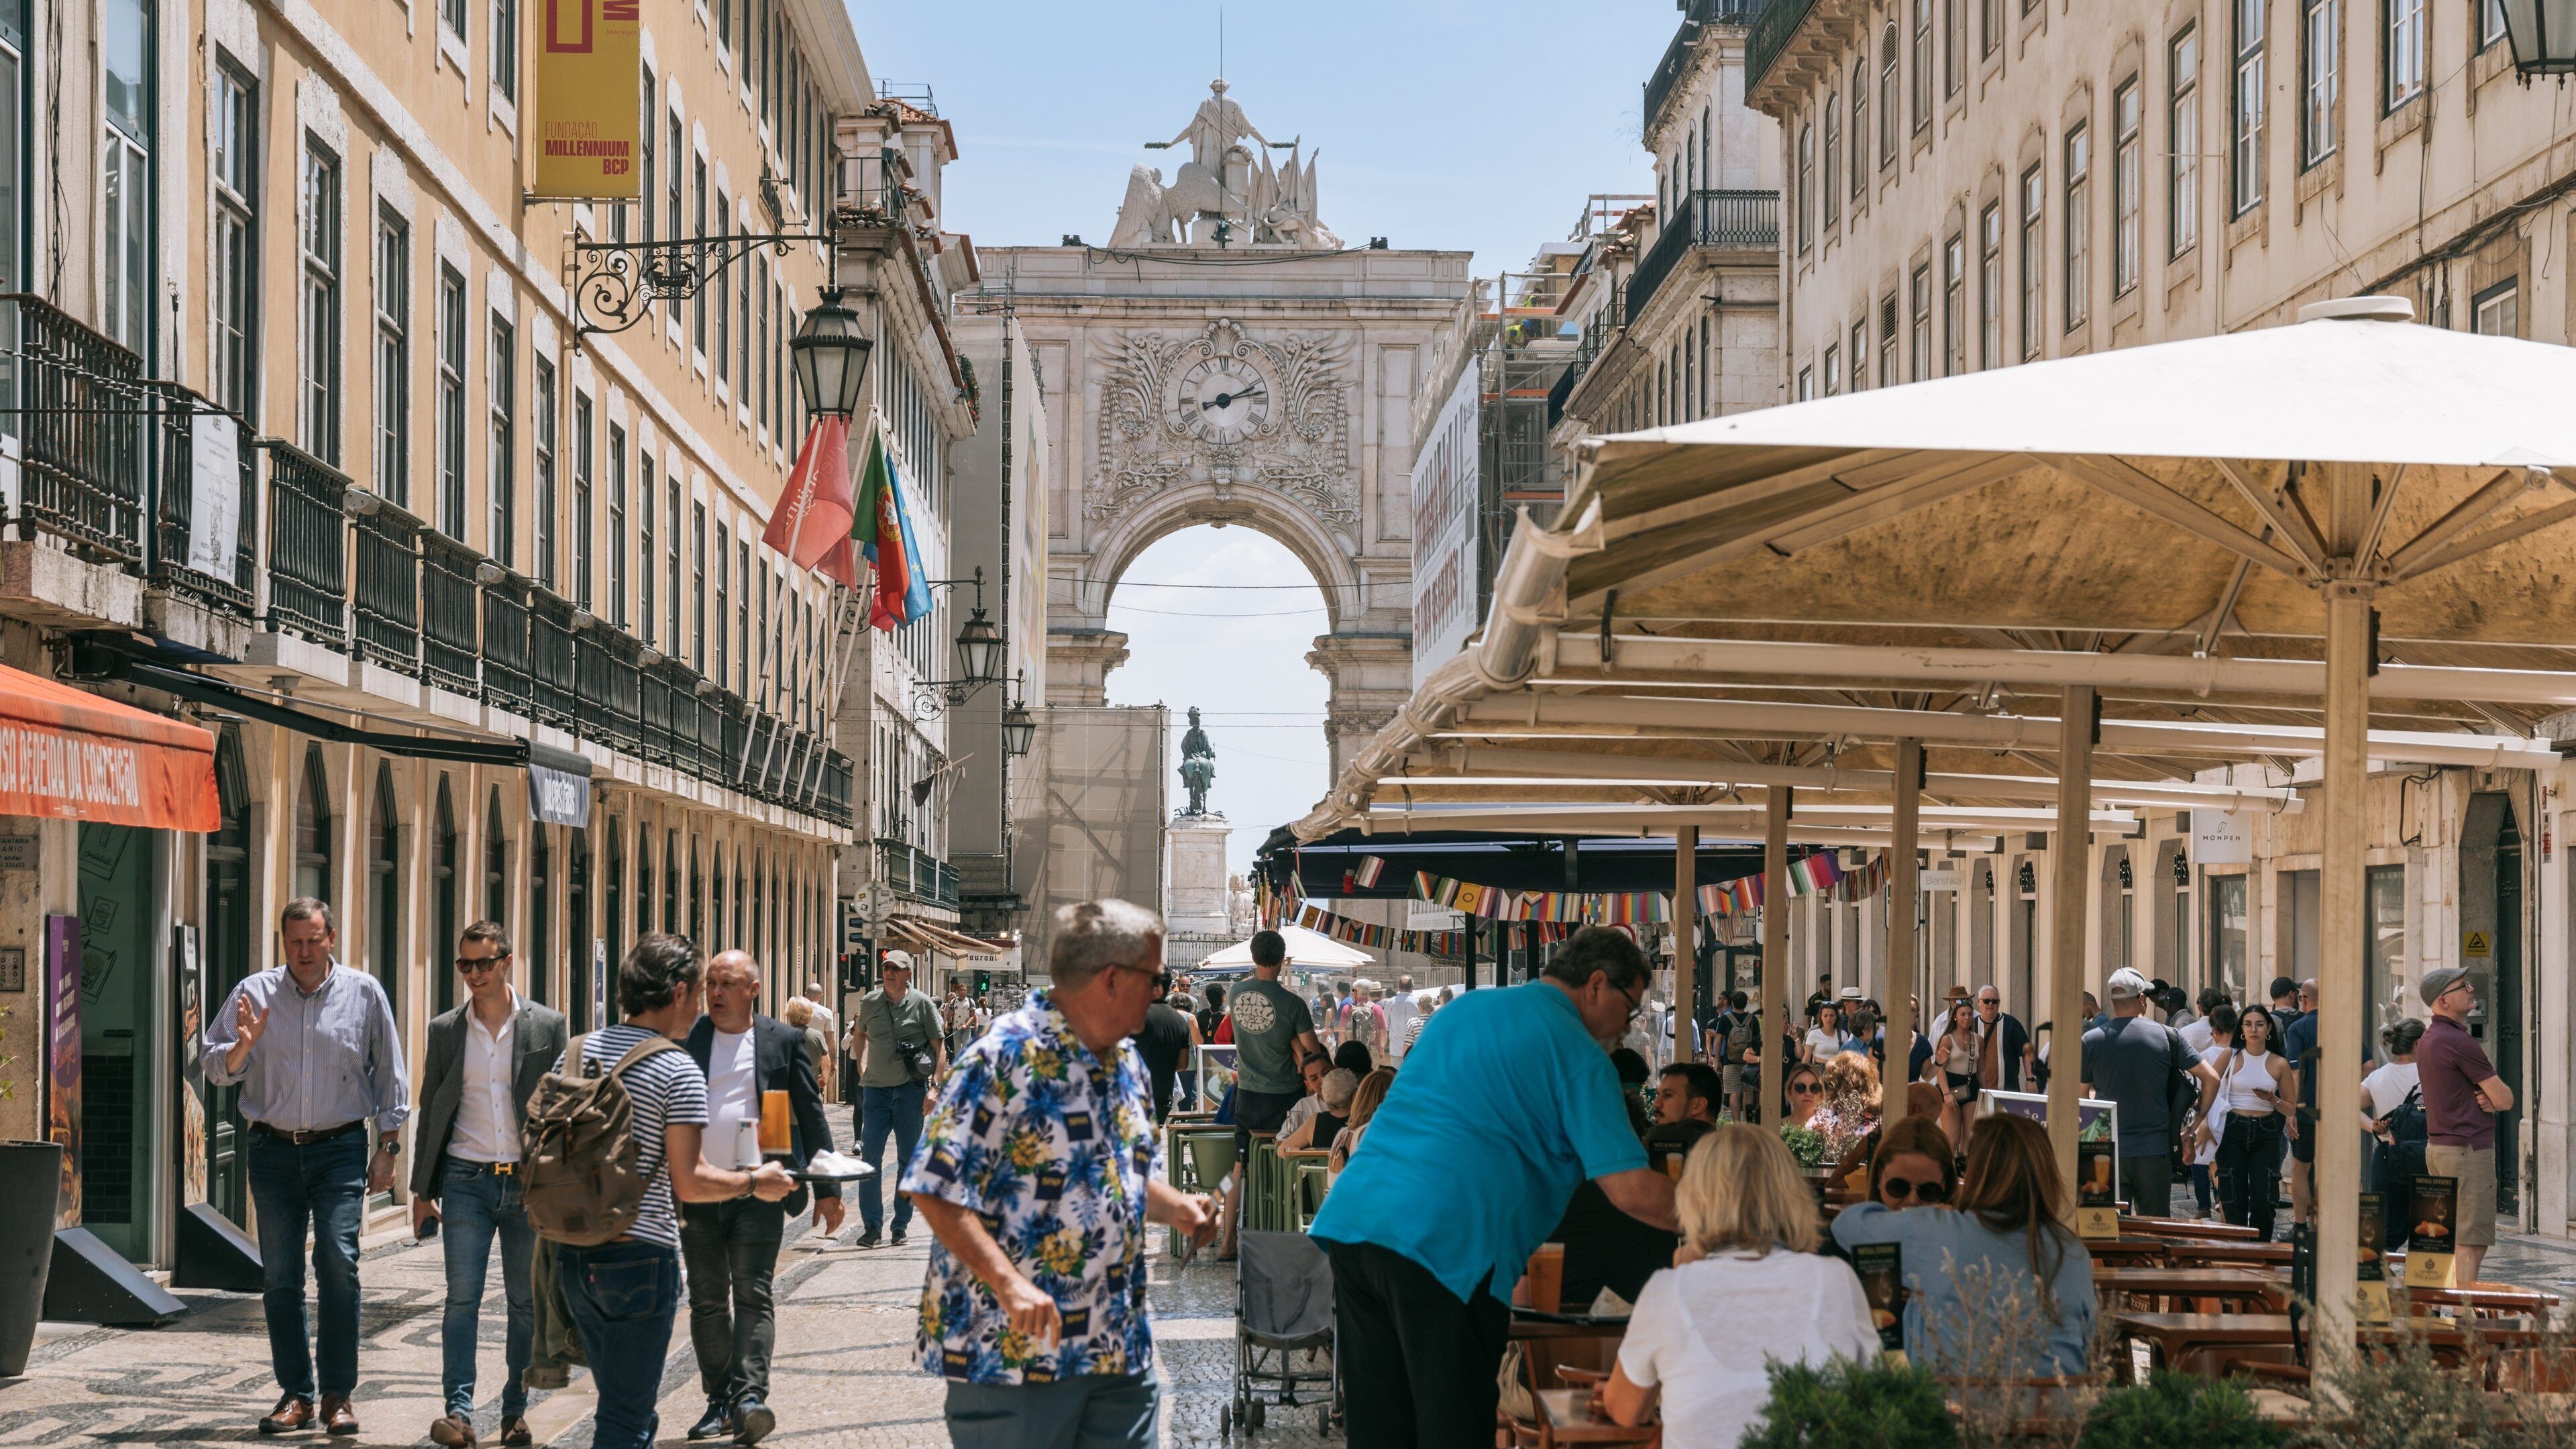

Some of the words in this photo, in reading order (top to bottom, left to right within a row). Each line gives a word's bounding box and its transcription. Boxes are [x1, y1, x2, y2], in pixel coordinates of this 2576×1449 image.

[545, 120, 598, 139] FUNDAÇÃO
[545, 140, 629, 156] MILLENNIUM
[602, 158, 629, 174] BCP
[0, 726, 17, 792] SA
[20, 729, 66, 798] PEREIRA
[67, 739, 83, 800] DA
[83, 742, 139, 808] CONCEIÇÃO
[1926, 875, 1962, 885] Bershka
[1235, 992, 1269, 1006] RIP
[1234, 1004, 1274, 1021] CURL
[1235, 1014, 1265, 1023] WET
[1240, 1019, 1271, 1030] SUITS
